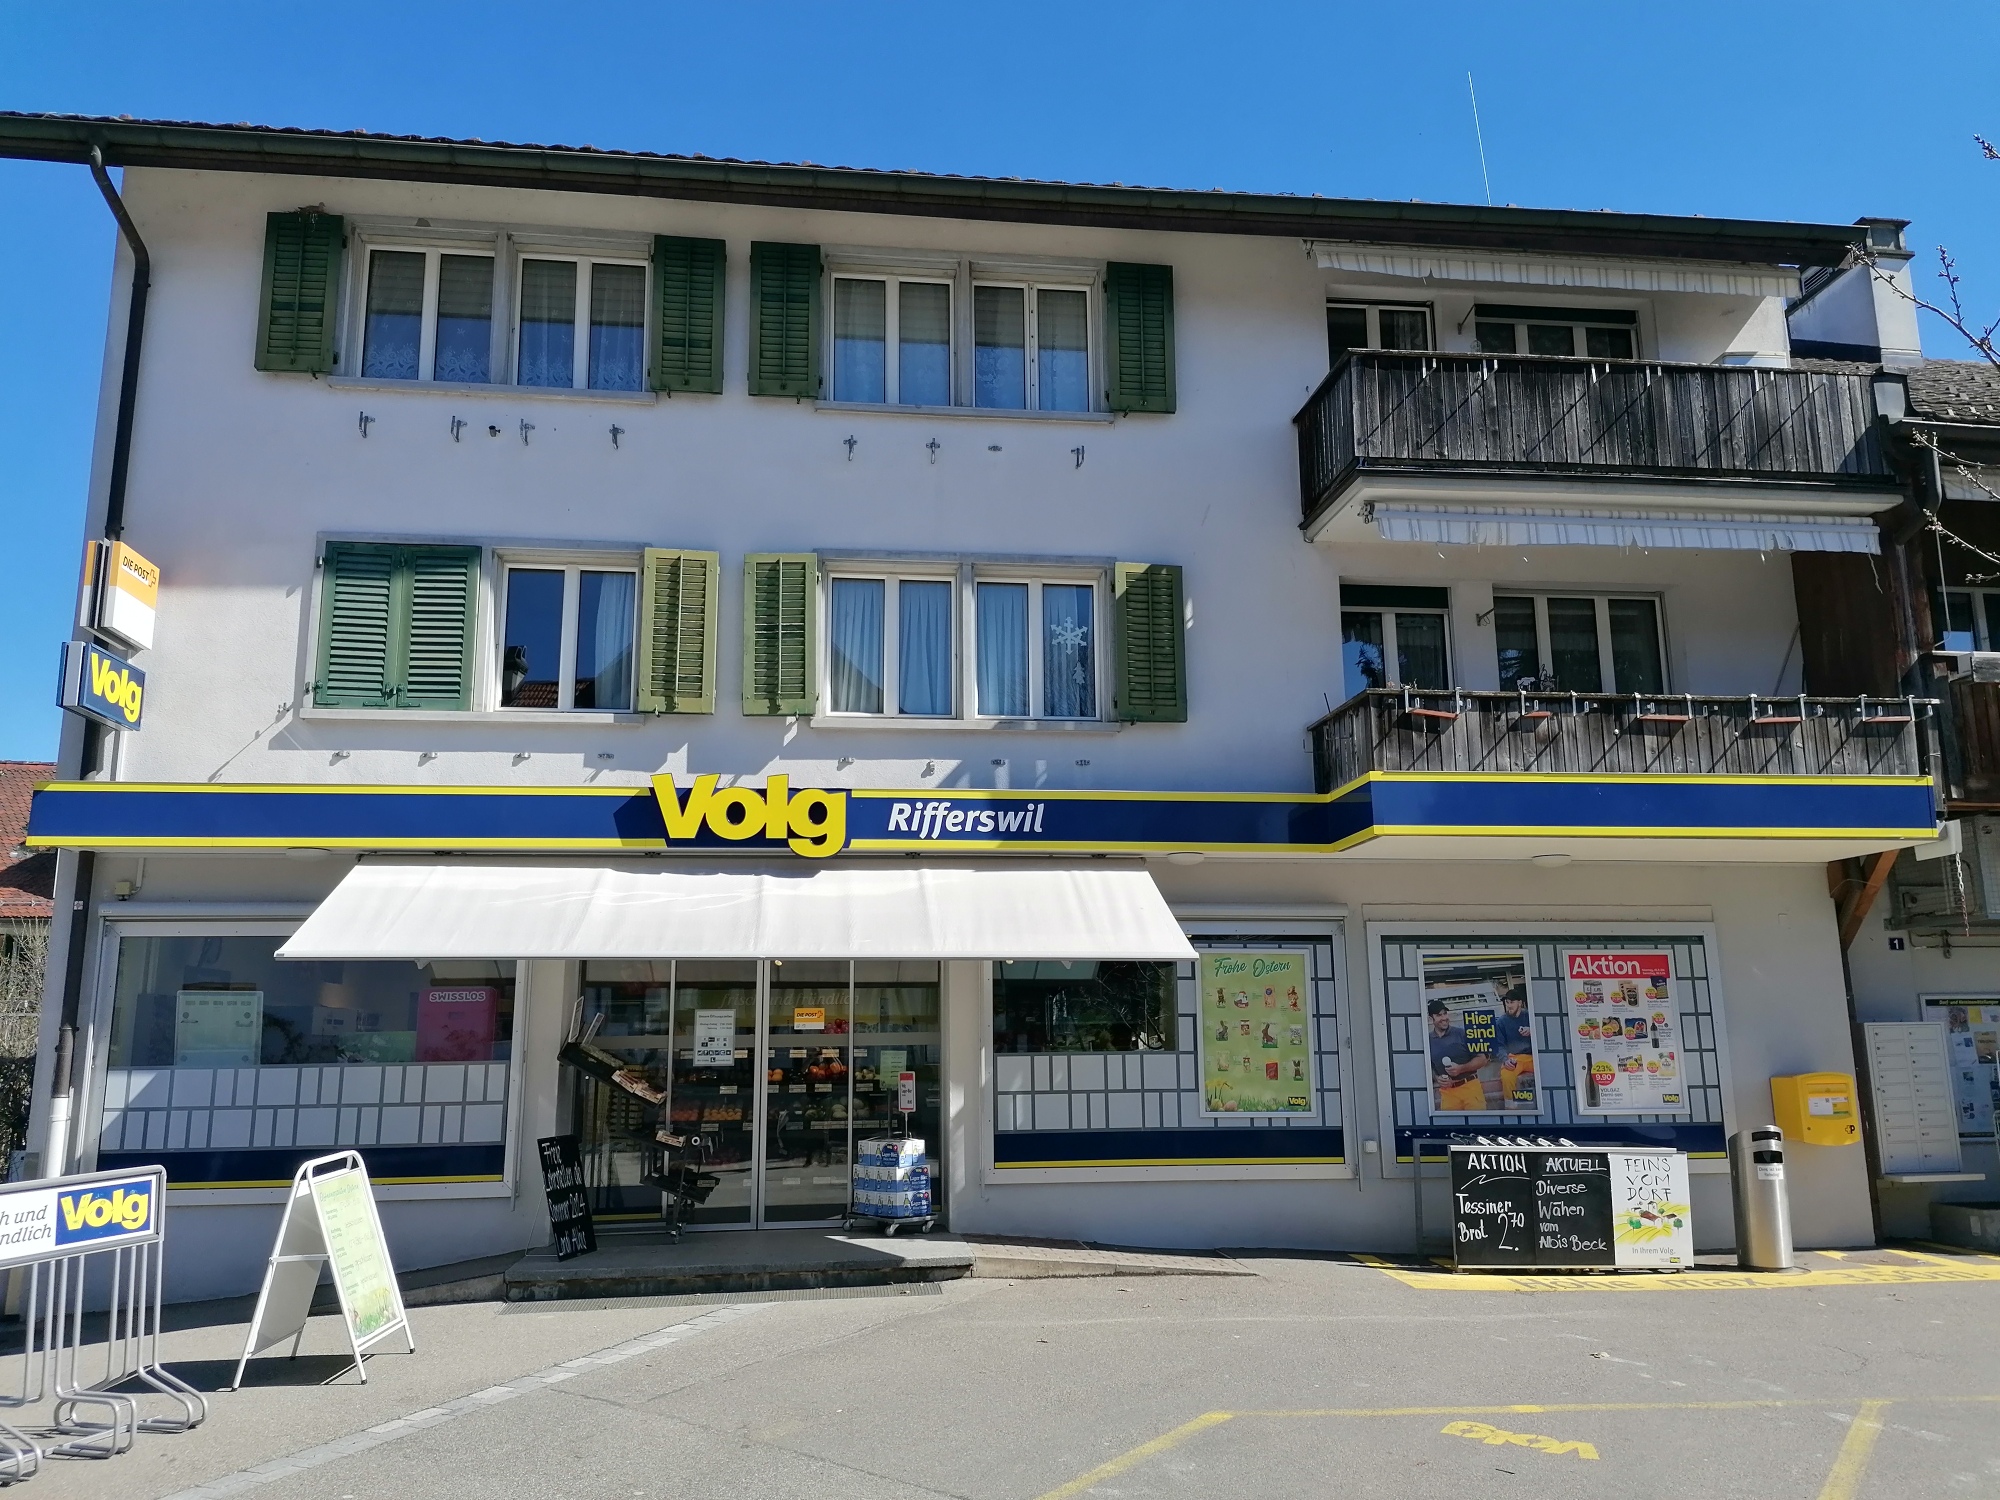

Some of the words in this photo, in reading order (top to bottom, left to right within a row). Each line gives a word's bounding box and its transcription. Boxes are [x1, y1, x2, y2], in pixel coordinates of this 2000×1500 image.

[122, 555, 133, 571] DIE
[133, 564, 150, 581] POST
[91, 652, 143, 723] Volg
[650, 773, 847, 858] Volg
[888, 803, 1045, 840] Rifferswil
[1893, 938, 1901, 949] 1
[1214, 957, 1247, 977] Frohe
[1253, 958, 1291, 978] Ostern
[1572, 955, 1641, 975] Aktion
[429, 991, 486, 1002] SWISSLOS
[721, 993, 757, 1008] frisc
[1464, 1012, 1494, 1025] Hier
[1466, 1025, 1496, 1039] sind
[1467, 1038, 1493, 1053] wir.
[1595, 1073, 1612, 1081] 9.90
[1289, 1097, 1306, 1106] Volg
[1513, 1091, 1533, 1101] Volg
[1467, 1152, 1528, 1173] AKTION
[1545, 1157, 1608, 1172] AKTUELL
[1535, 1179, 1588, 1196] Diverse
[1626, 1173, 1670, 1186] VOM
[1627, 1186, 1672, 1202] DORF
[61, 1188, 149, 1231] Volg
[1455, 1193, 1512, 1215] Tessiner
[14, 1204, 49, 1224] und
[1457, 1218, 1489, 1243] Brot
[1539, 1222, 1559, 1233] vom
[1569, 1234, 1608, 1252] Beck
[1659, 1247, 1676, 1256] Volg.
[1508, 1276, 1646, 1291] Höhe
[1657, 1274, 1788, 1289] max.
